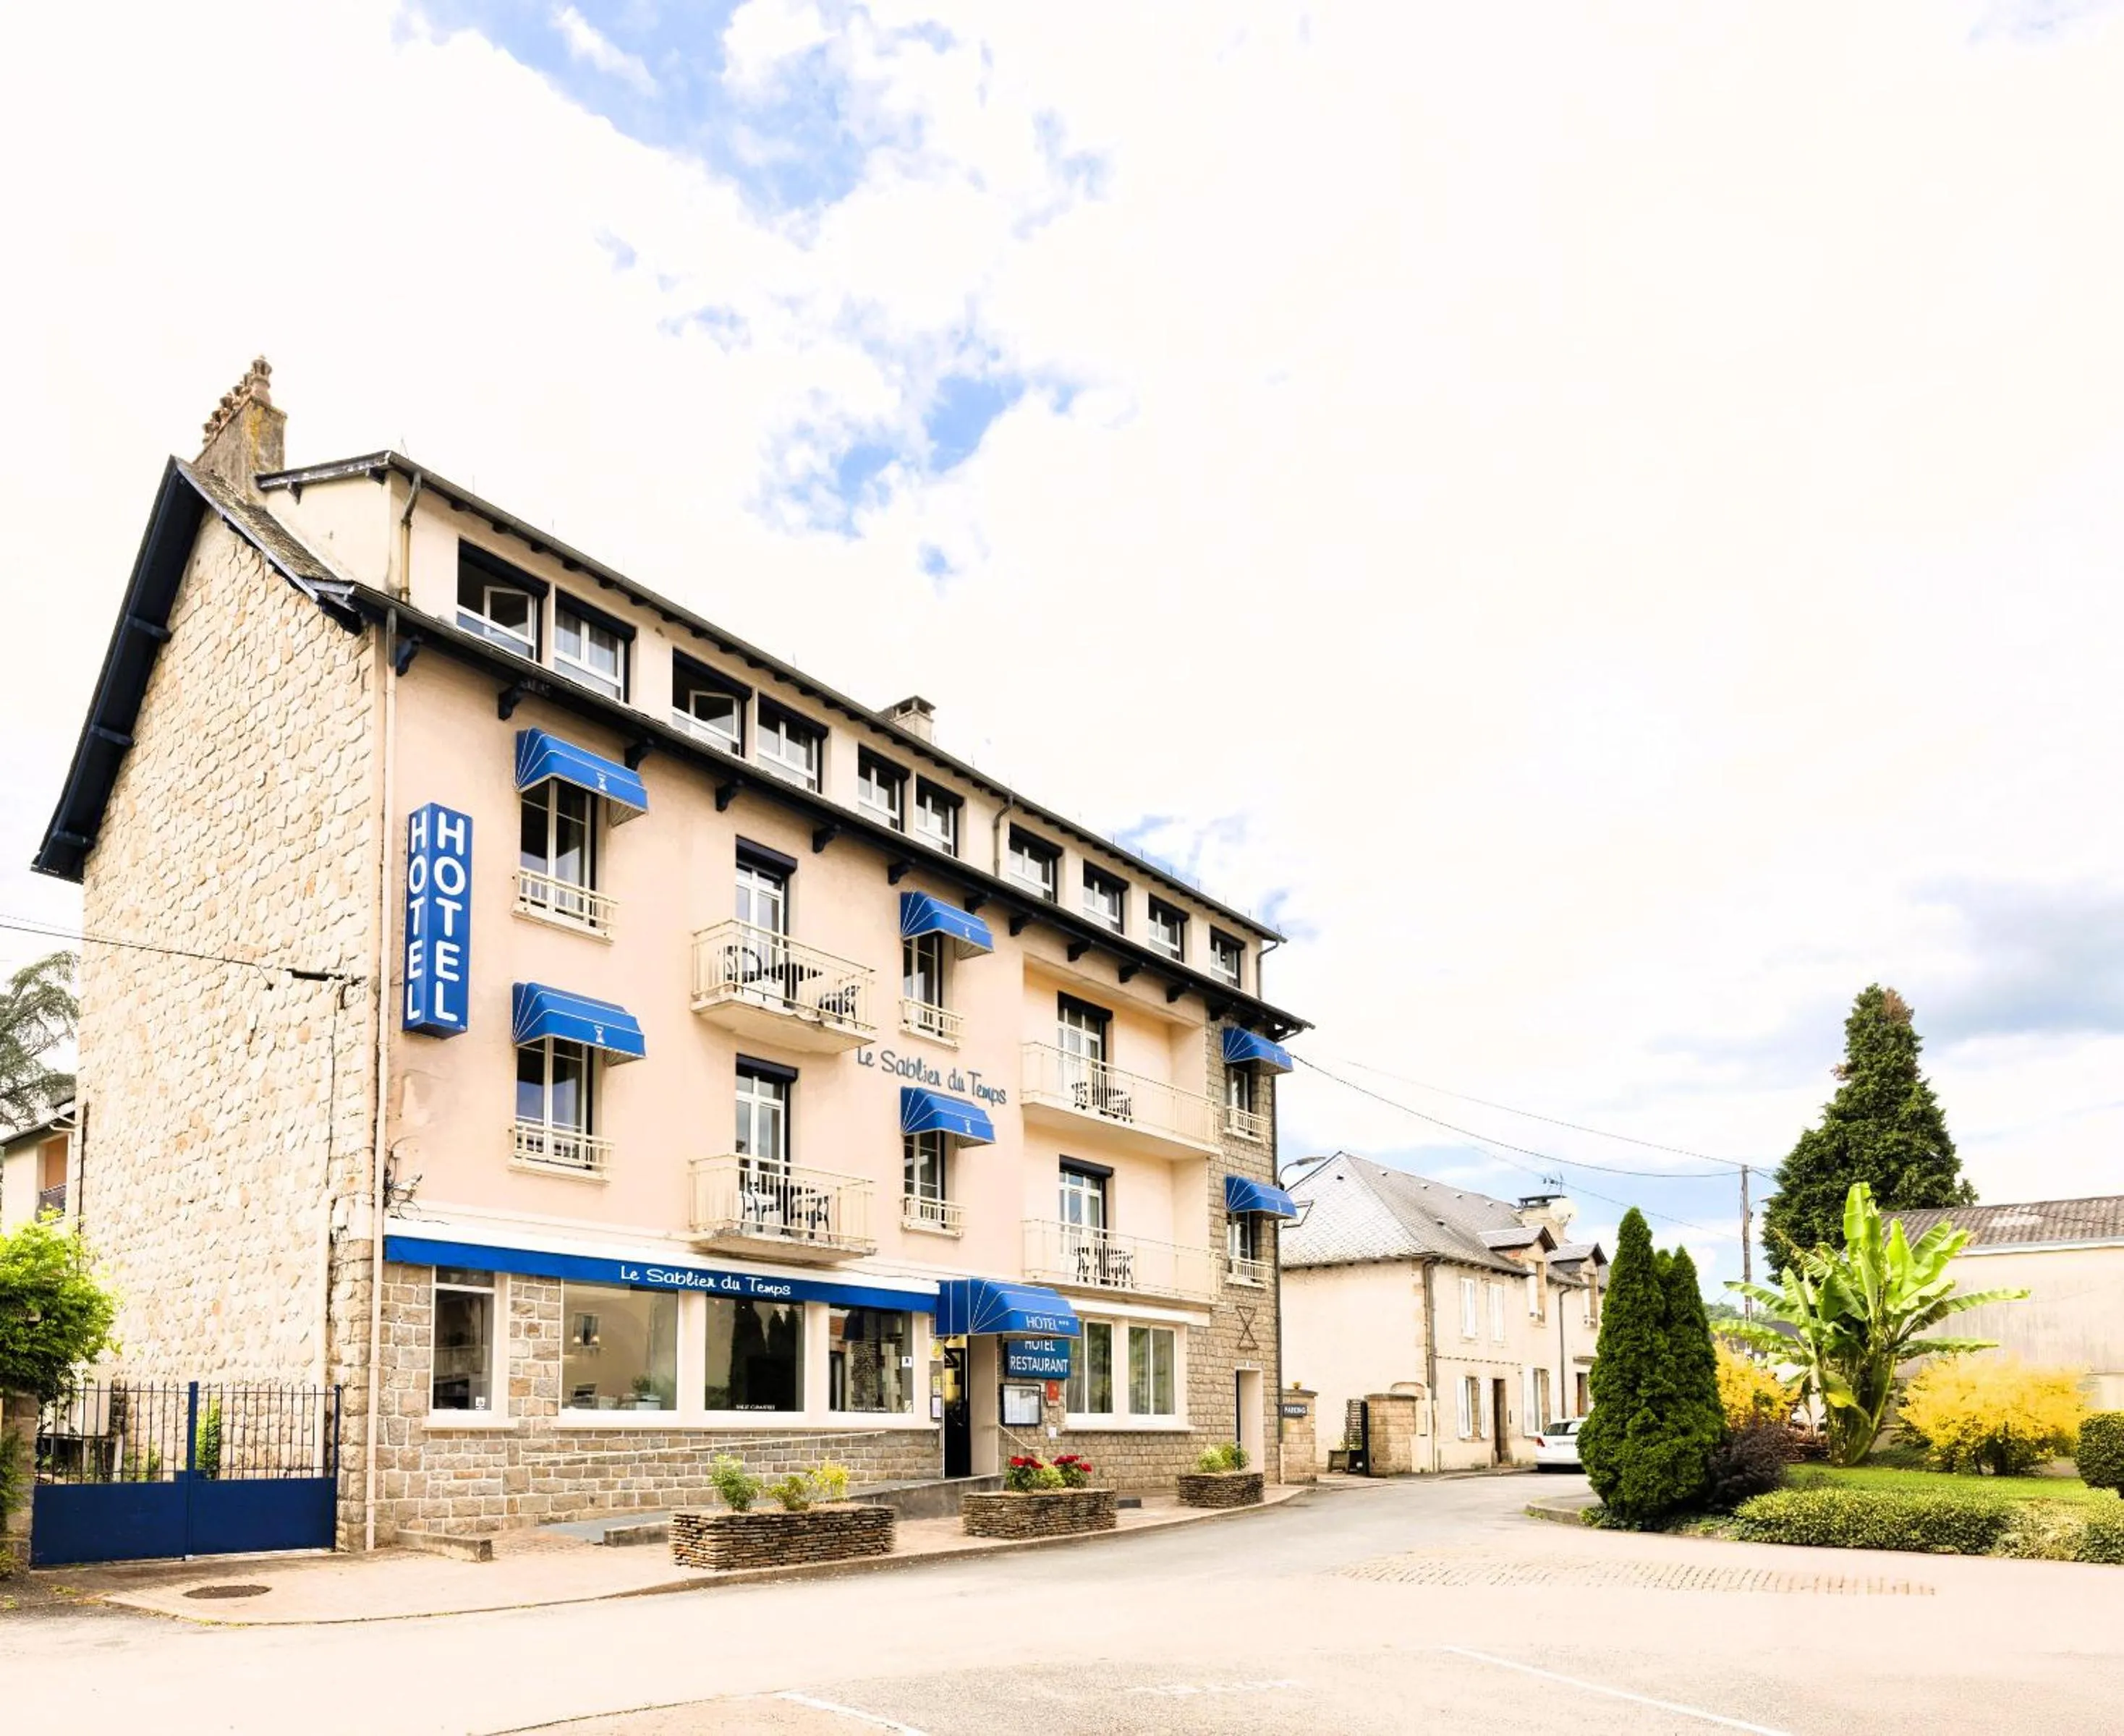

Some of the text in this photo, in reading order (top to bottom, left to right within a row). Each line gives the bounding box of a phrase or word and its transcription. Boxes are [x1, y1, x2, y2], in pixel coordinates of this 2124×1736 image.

[407, 811, 428, 1021] HOTEL
[433, 811, 467, 1022] HOTEL
[857, 1047, 1007, 1107] Le Sablier du Temps
[620, 1265, 791, 1297] Le Sablier du Temps
[1025, 1316, 1058, 1331] HOTEL
[1024, 1340, 1055, 1352] HOTEL
[1010, 1356, 1068, 1373] RESTAURANT
